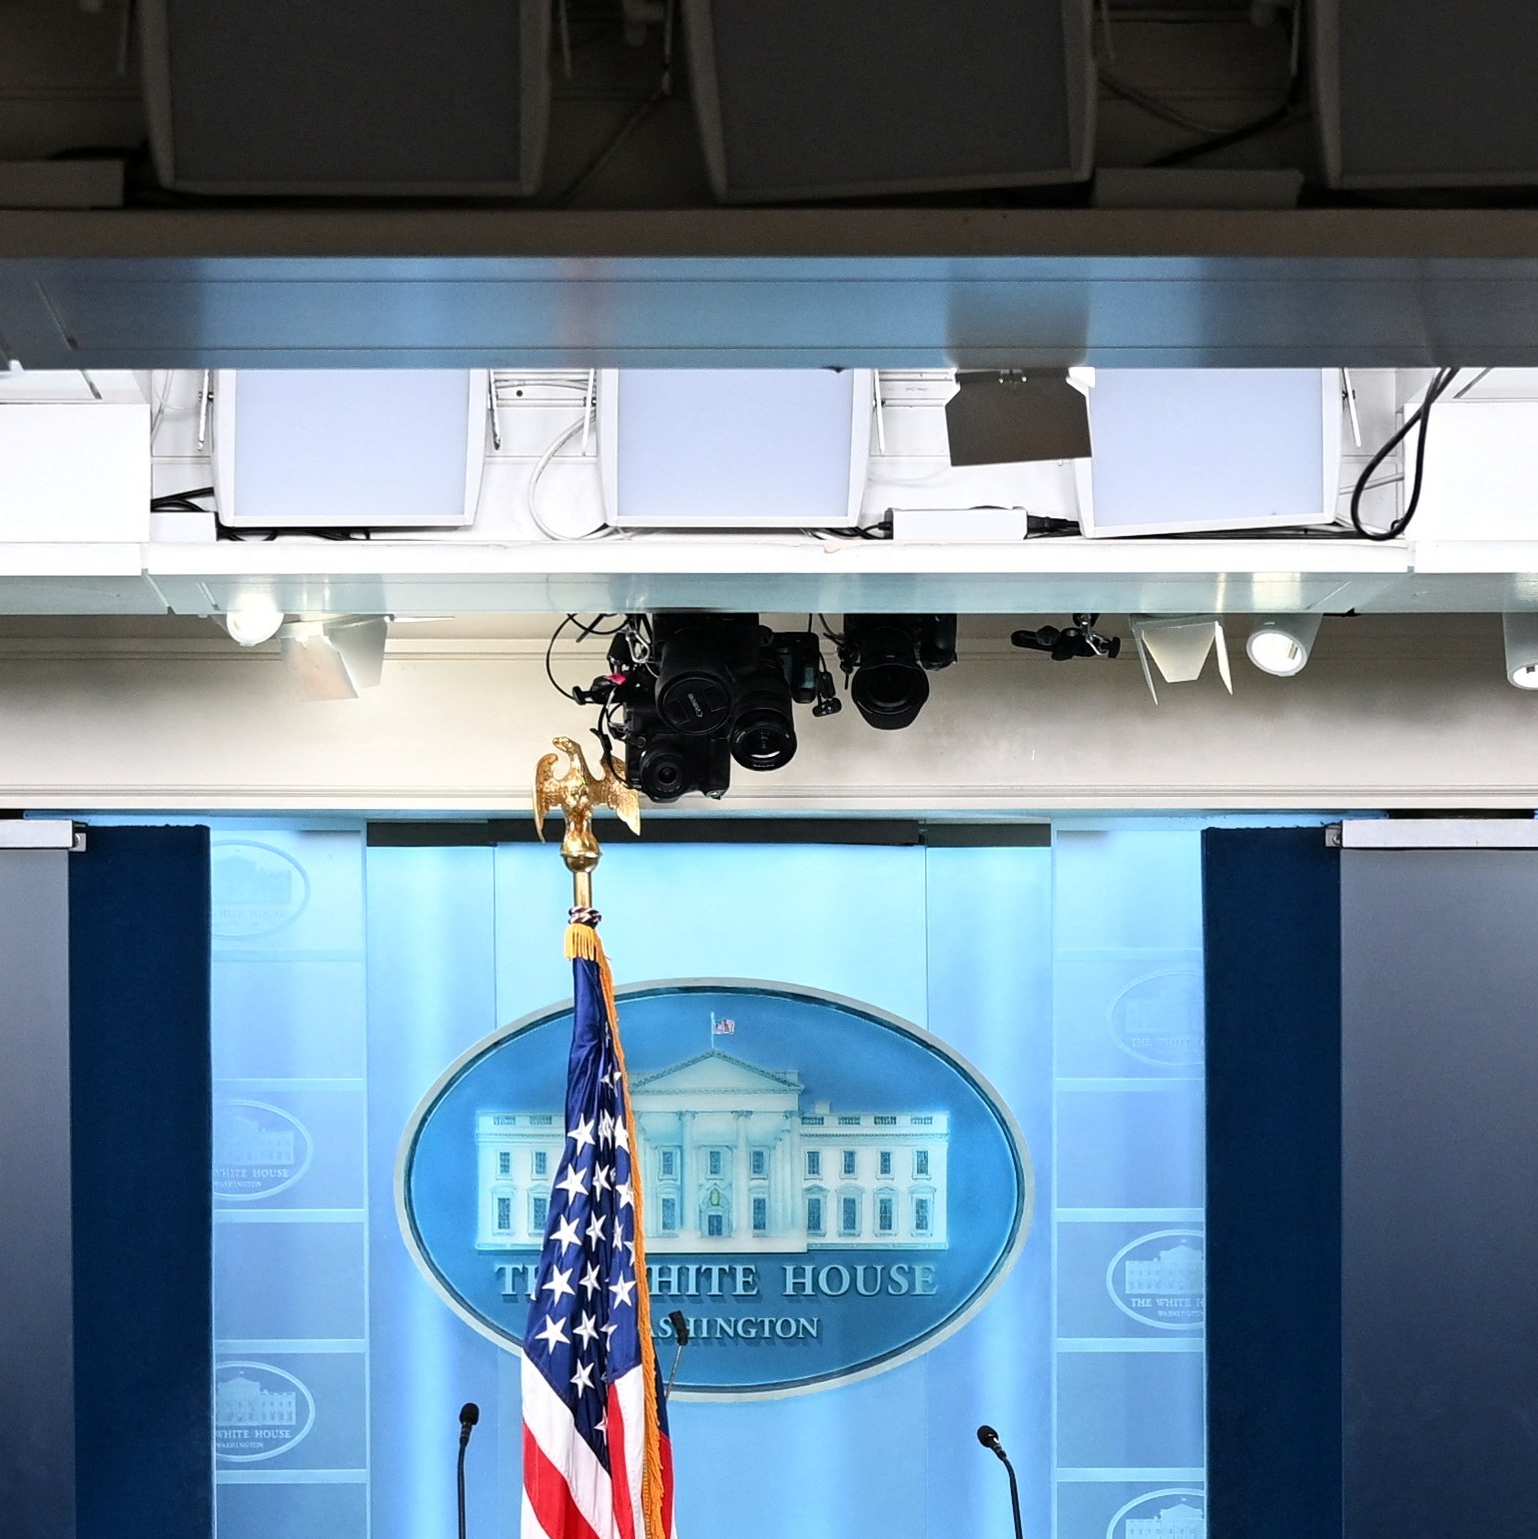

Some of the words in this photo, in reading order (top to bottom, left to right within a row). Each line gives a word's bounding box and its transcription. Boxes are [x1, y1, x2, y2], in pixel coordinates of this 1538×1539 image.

[252, 1168, 290, 1178] HOUSE
[646, 1264, 758, 1296] HITE
[782, 1264, 938, 1296] HOUSE
[1130, 1298, 1153, 1308] THE
[1155, 1298, 1192, 1308] WHITE
[255, 1429, 292, 1439] HOUSE
